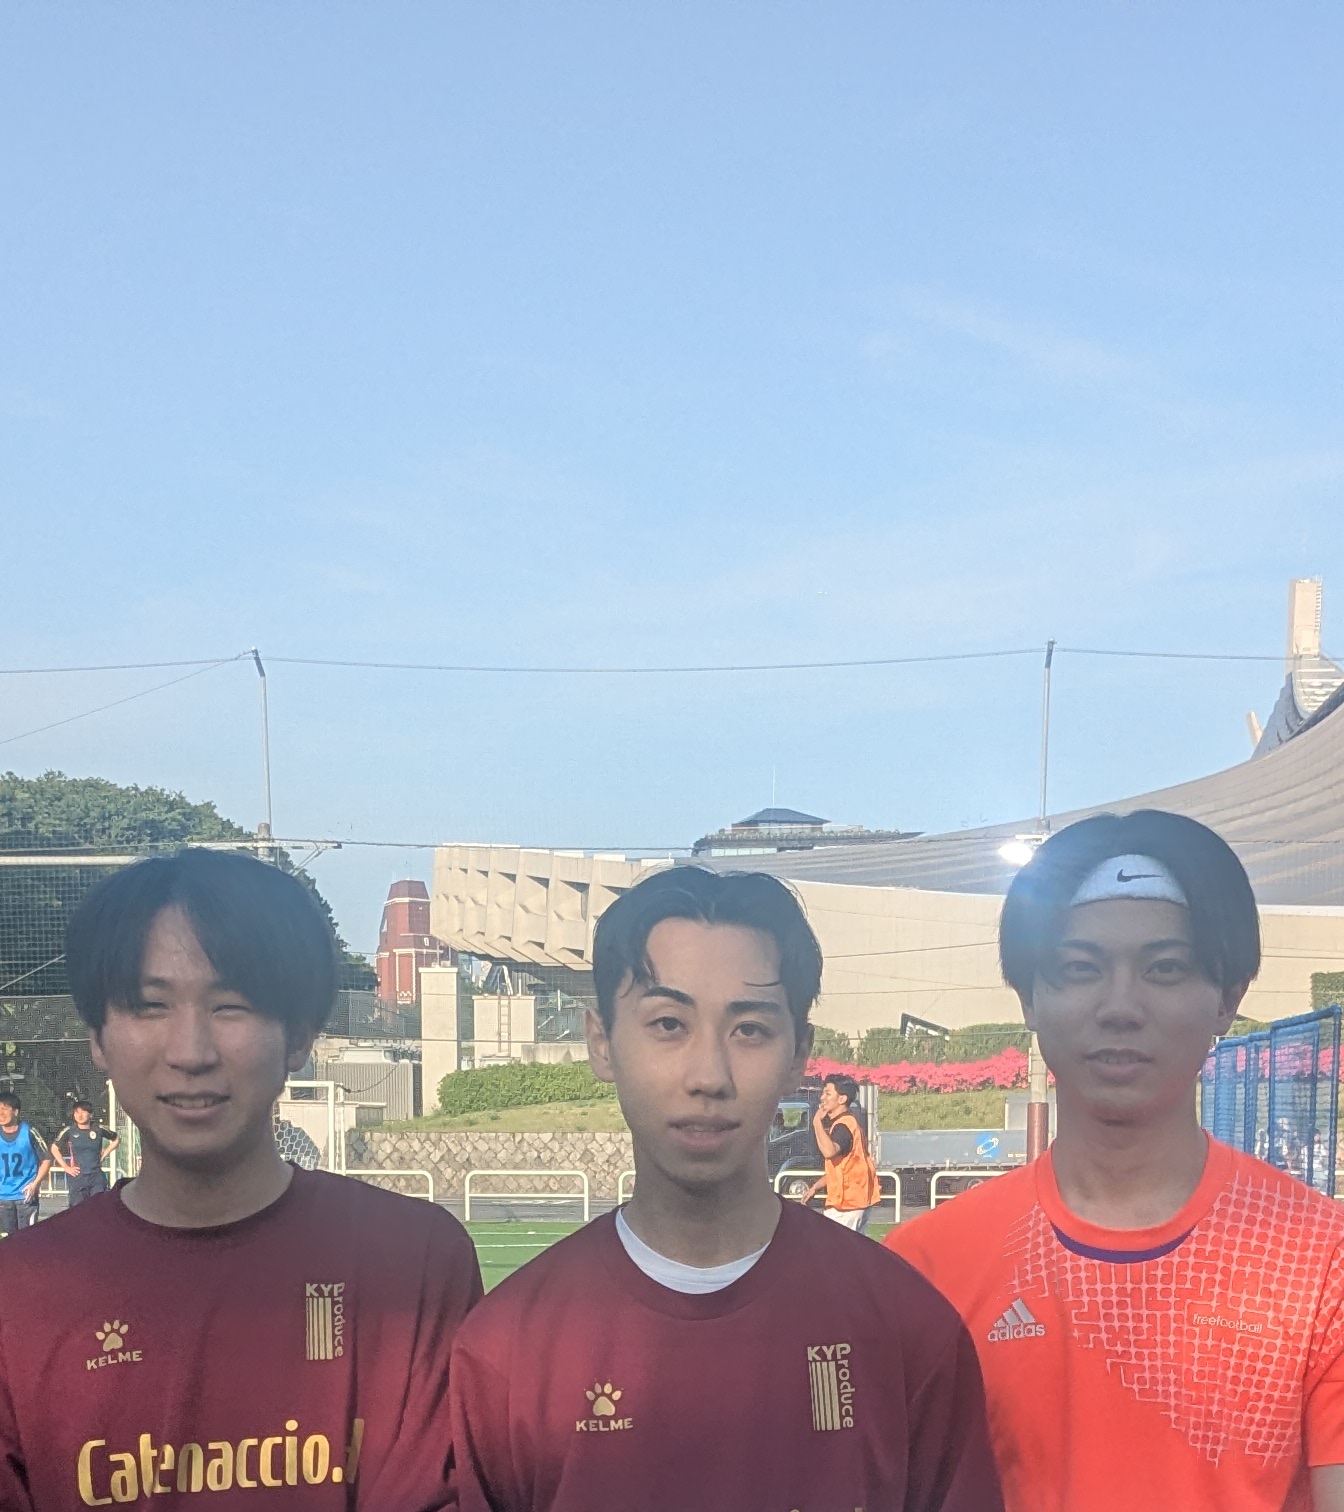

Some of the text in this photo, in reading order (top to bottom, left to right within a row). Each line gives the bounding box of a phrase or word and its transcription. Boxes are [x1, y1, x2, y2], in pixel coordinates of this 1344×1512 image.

[1, 1153, 24, 1178] 12
[988, 1322, 1046, 1342] adidas
[86, 1350, 143, 1370] KELME
[575, 1418, 633, 1432] KELME
